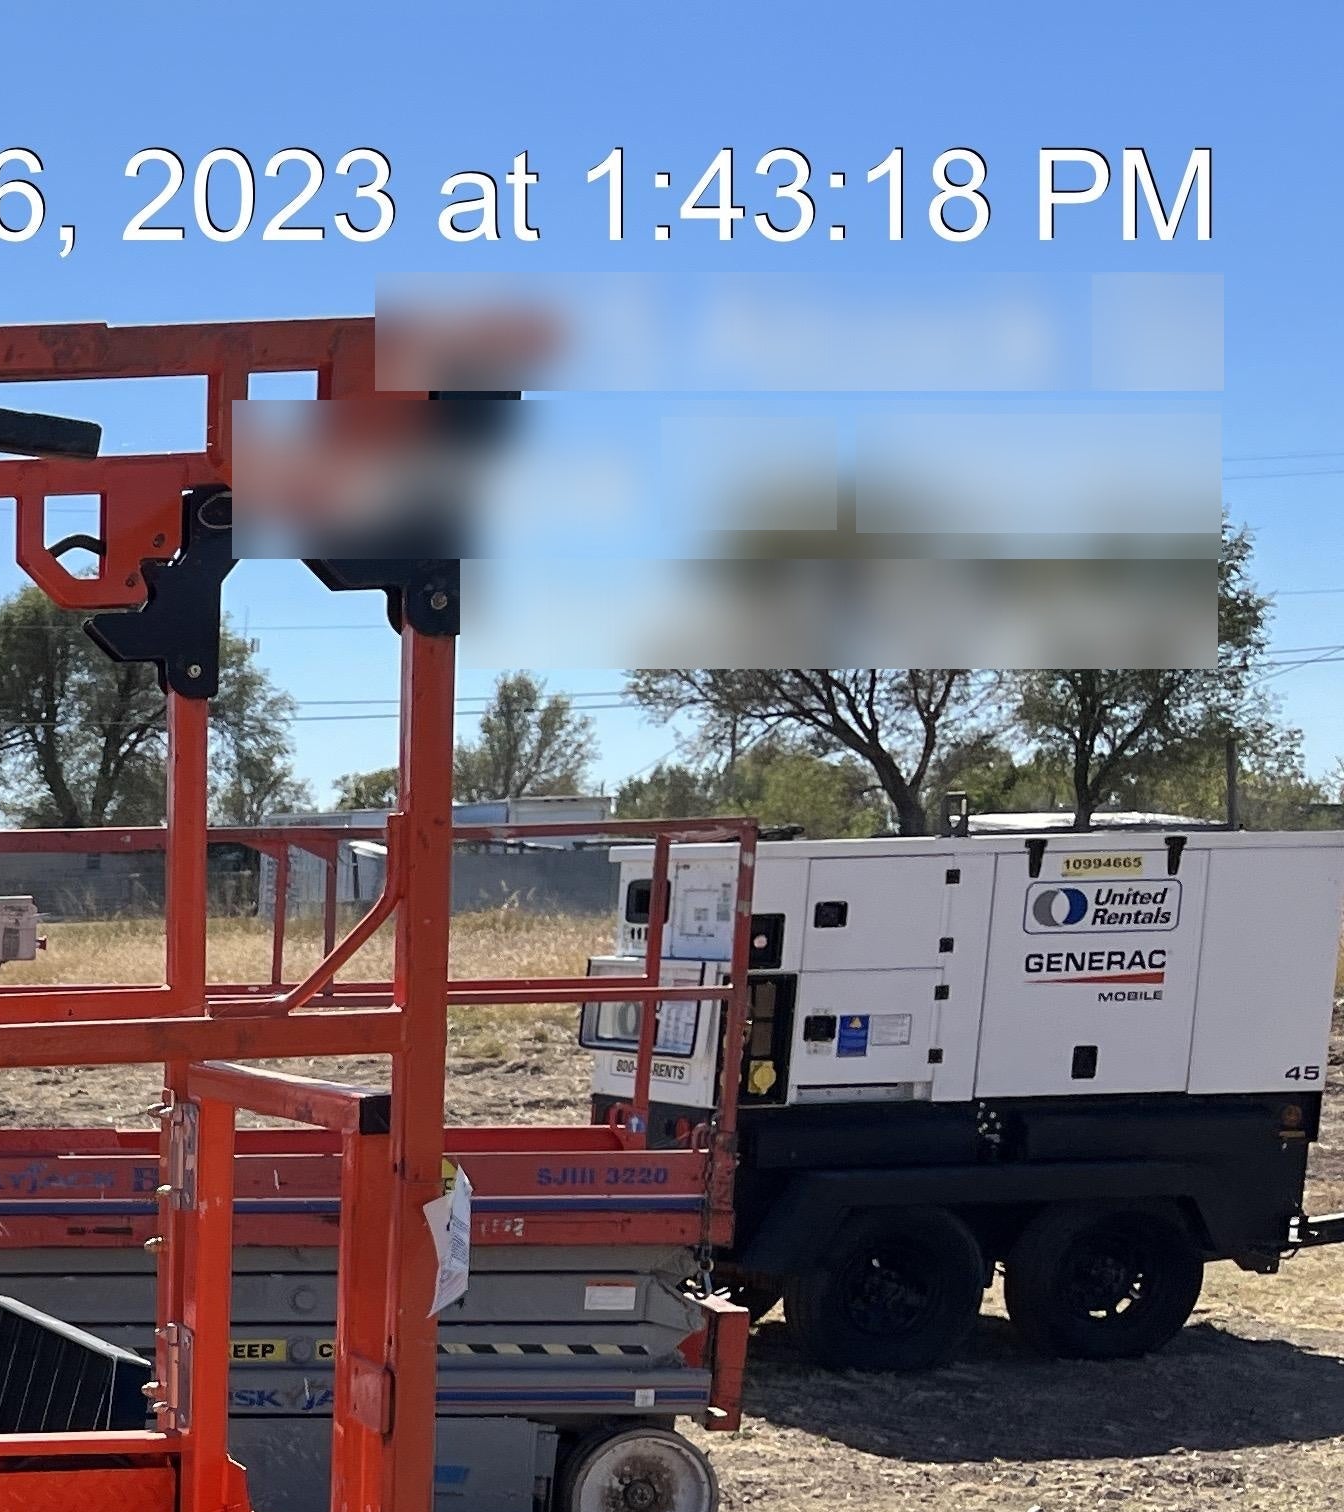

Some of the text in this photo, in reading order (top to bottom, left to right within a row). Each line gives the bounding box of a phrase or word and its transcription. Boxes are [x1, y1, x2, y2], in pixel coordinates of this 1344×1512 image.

[1063, 857, 1143, 870] 10994665
[1094, 887, 1168, 906] United
[1091, 907, 1172, 925] Rentals
[1024, 949, 1167, 973] GENERAC
[1097, 990, 1163, 1002] MOBILE
[1285, 1065, 1320, 1080] 45
[605, 1167, 668, 1185] 3220
